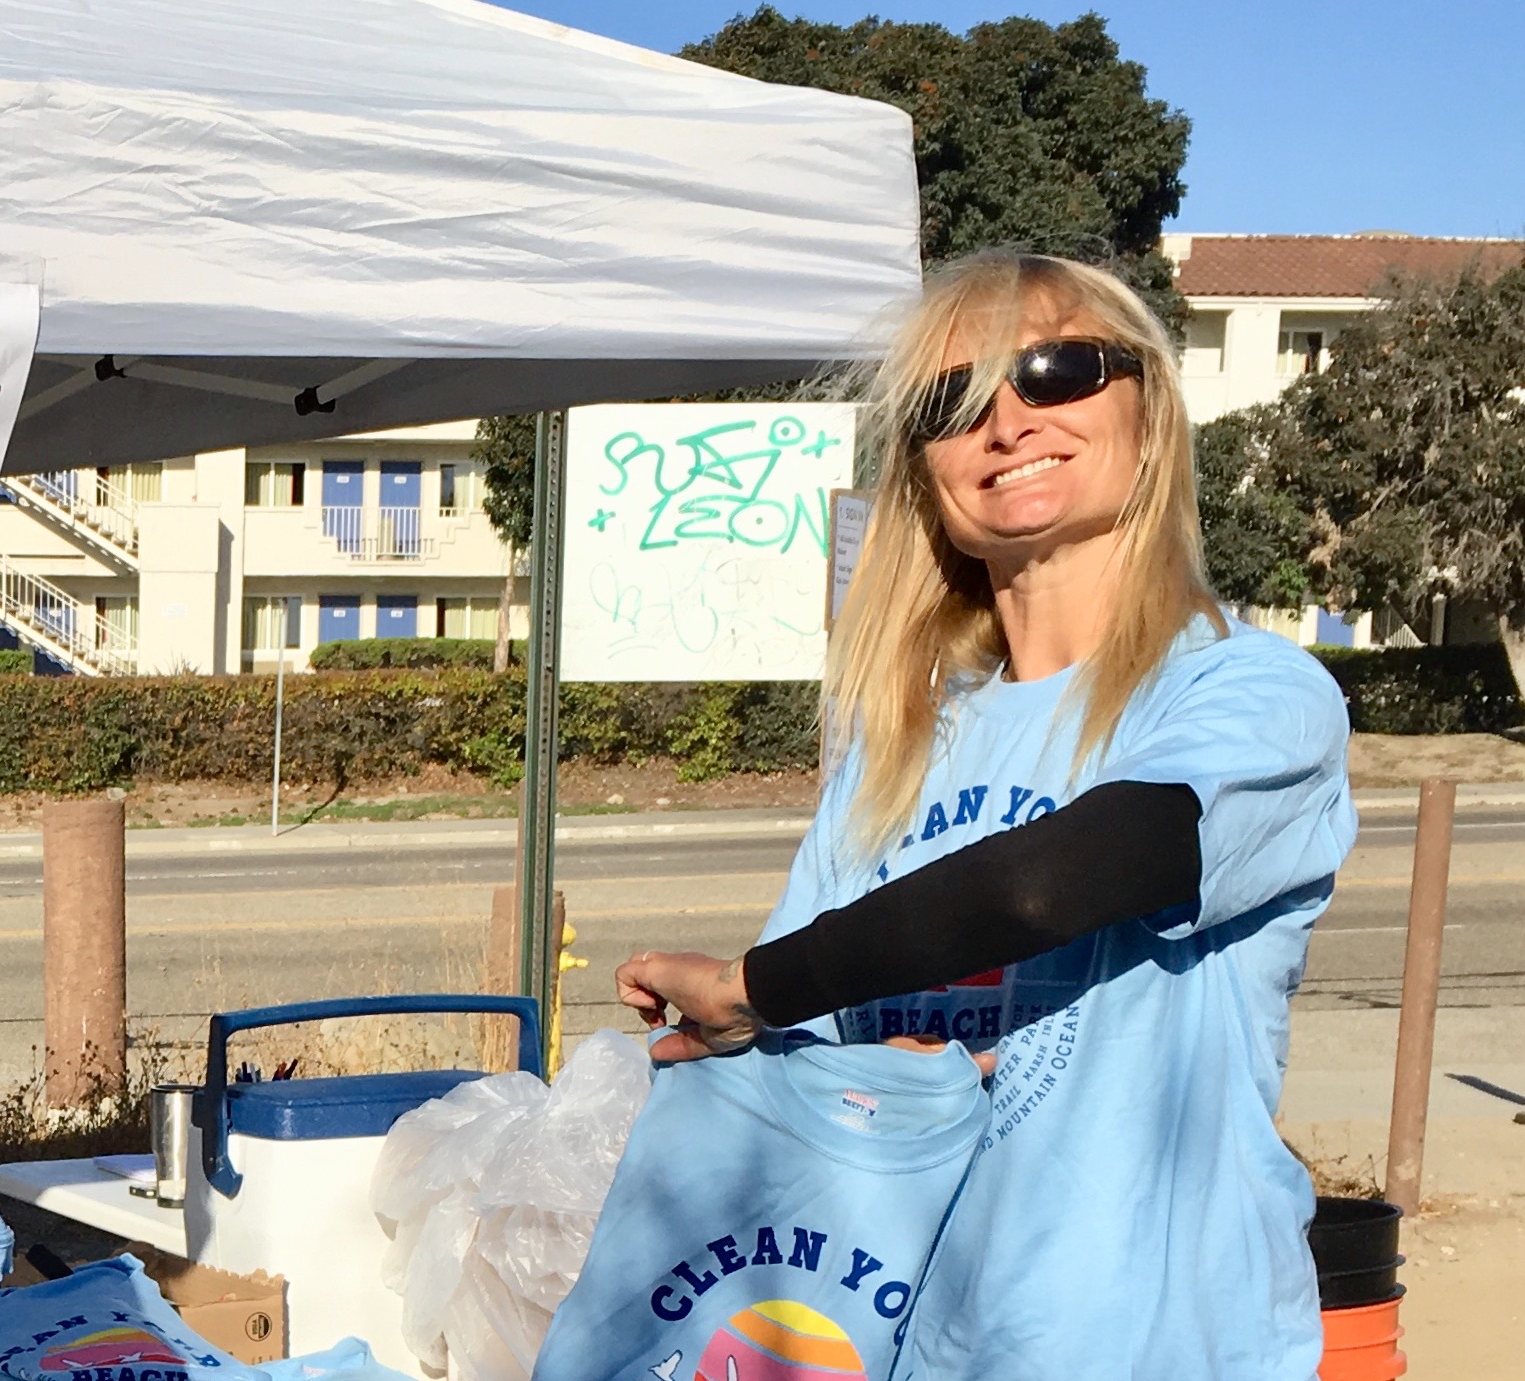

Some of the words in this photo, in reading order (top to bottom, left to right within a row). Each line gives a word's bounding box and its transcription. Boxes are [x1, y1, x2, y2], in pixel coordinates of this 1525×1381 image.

[880, 1005, 1002, 1040] BEACH
[1051, 1006, 1079, 1070] OCEAN
[1023, 1045, 1048, 1081] MARSH
[994, 1087, 1022, 1114] TRAIL
[997, 1073, 1057, 1141] MOUNTAIN
[651, 1226, 828, 1321] CLEAN
